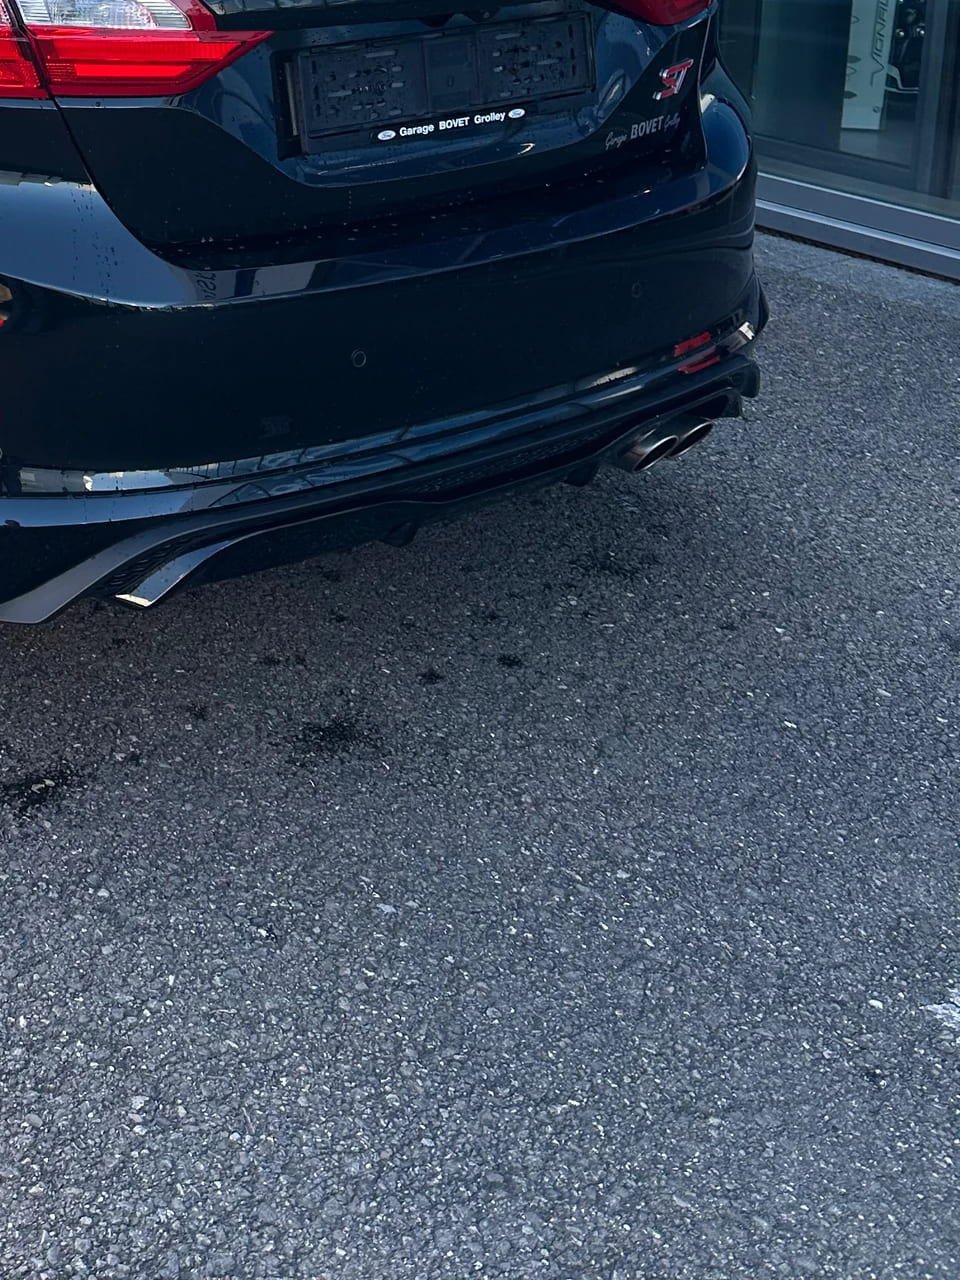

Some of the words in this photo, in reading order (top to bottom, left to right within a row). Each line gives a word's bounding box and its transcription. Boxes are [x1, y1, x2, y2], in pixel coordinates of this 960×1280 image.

[652, 58, 694, 101] ST
[400, 124, 434, 137] Garage
[438, 116, 470, 130] BOVET
[474, 111, 506, 125] Grolley
[630, 115, 664, 140] BOVET
